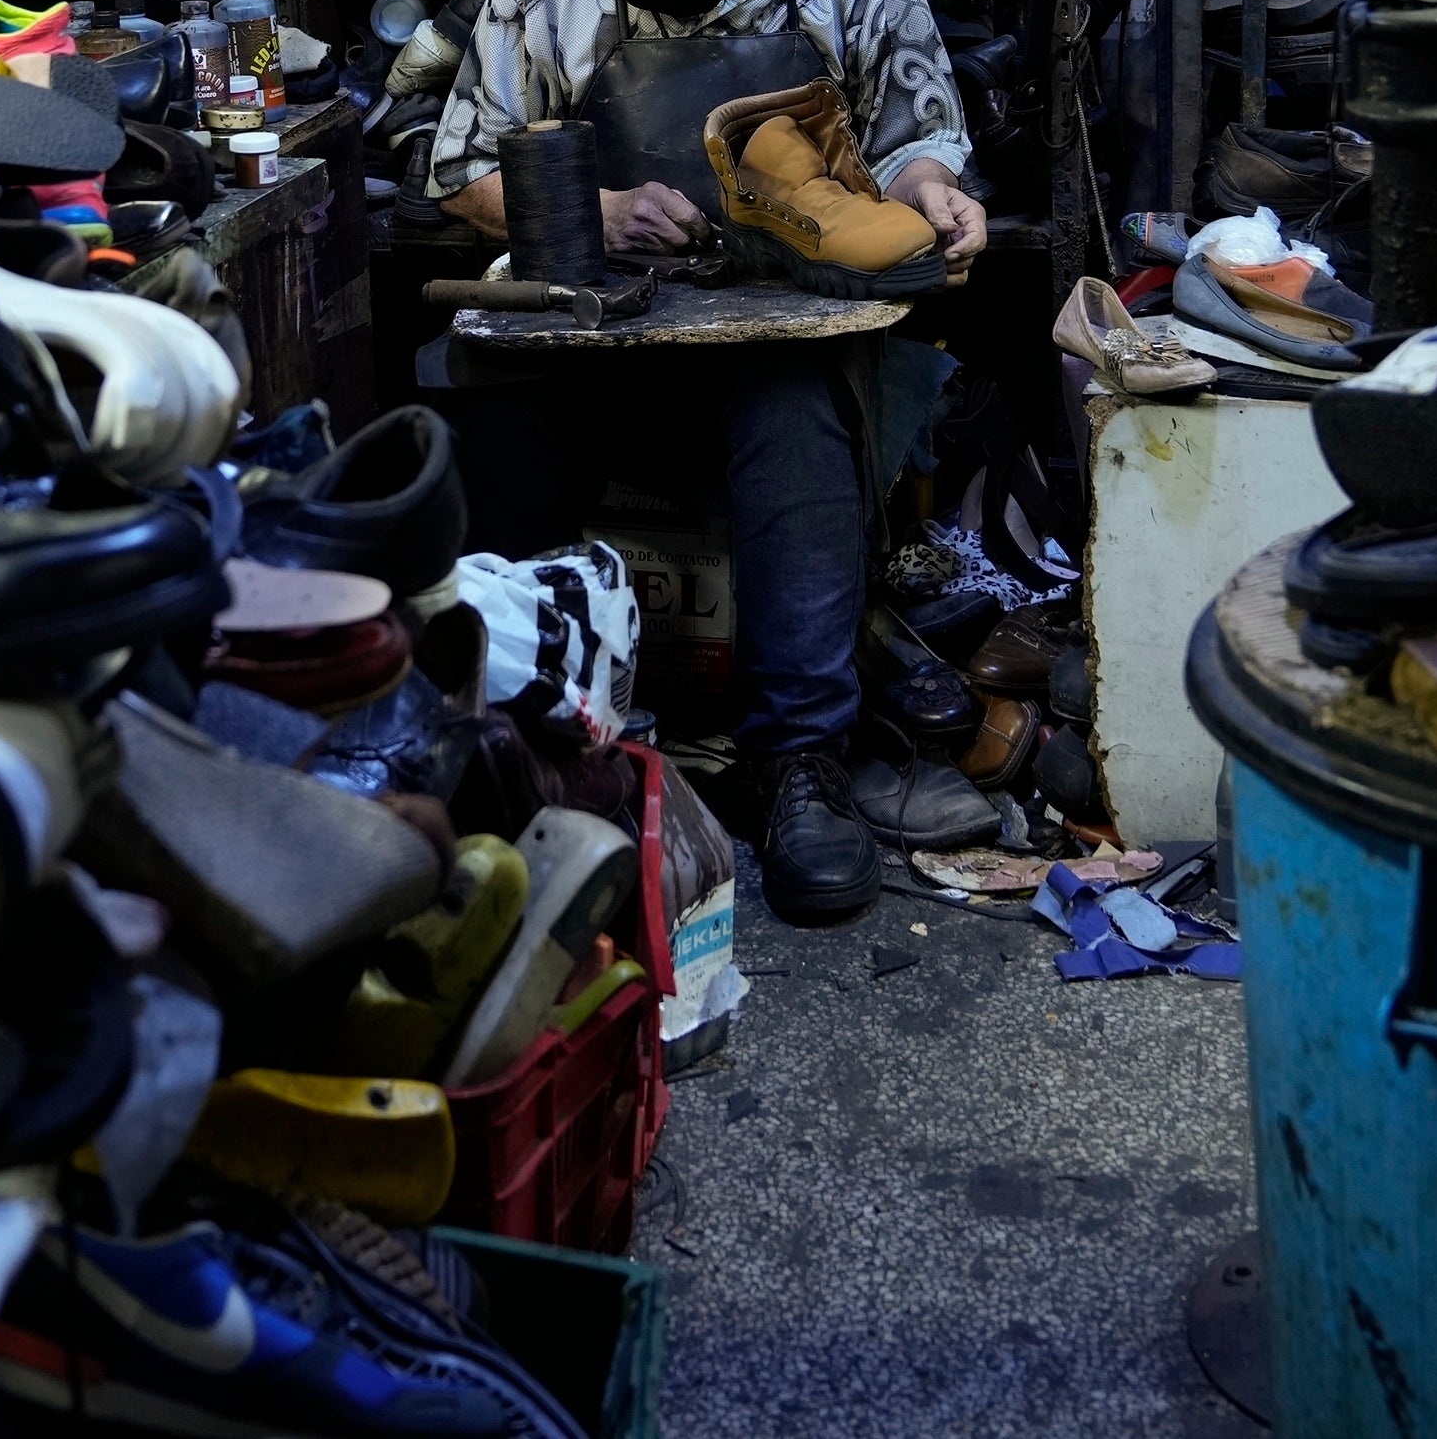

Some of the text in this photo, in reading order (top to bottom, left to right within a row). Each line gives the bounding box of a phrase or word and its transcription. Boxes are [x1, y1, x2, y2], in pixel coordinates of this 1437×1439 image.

[198, 70, 226, 93] COLOR
[198, 91, 217, 99] Cuero
[638, 550, 654, 562] DE
[657, 552, 721, 568] CONTACTO
